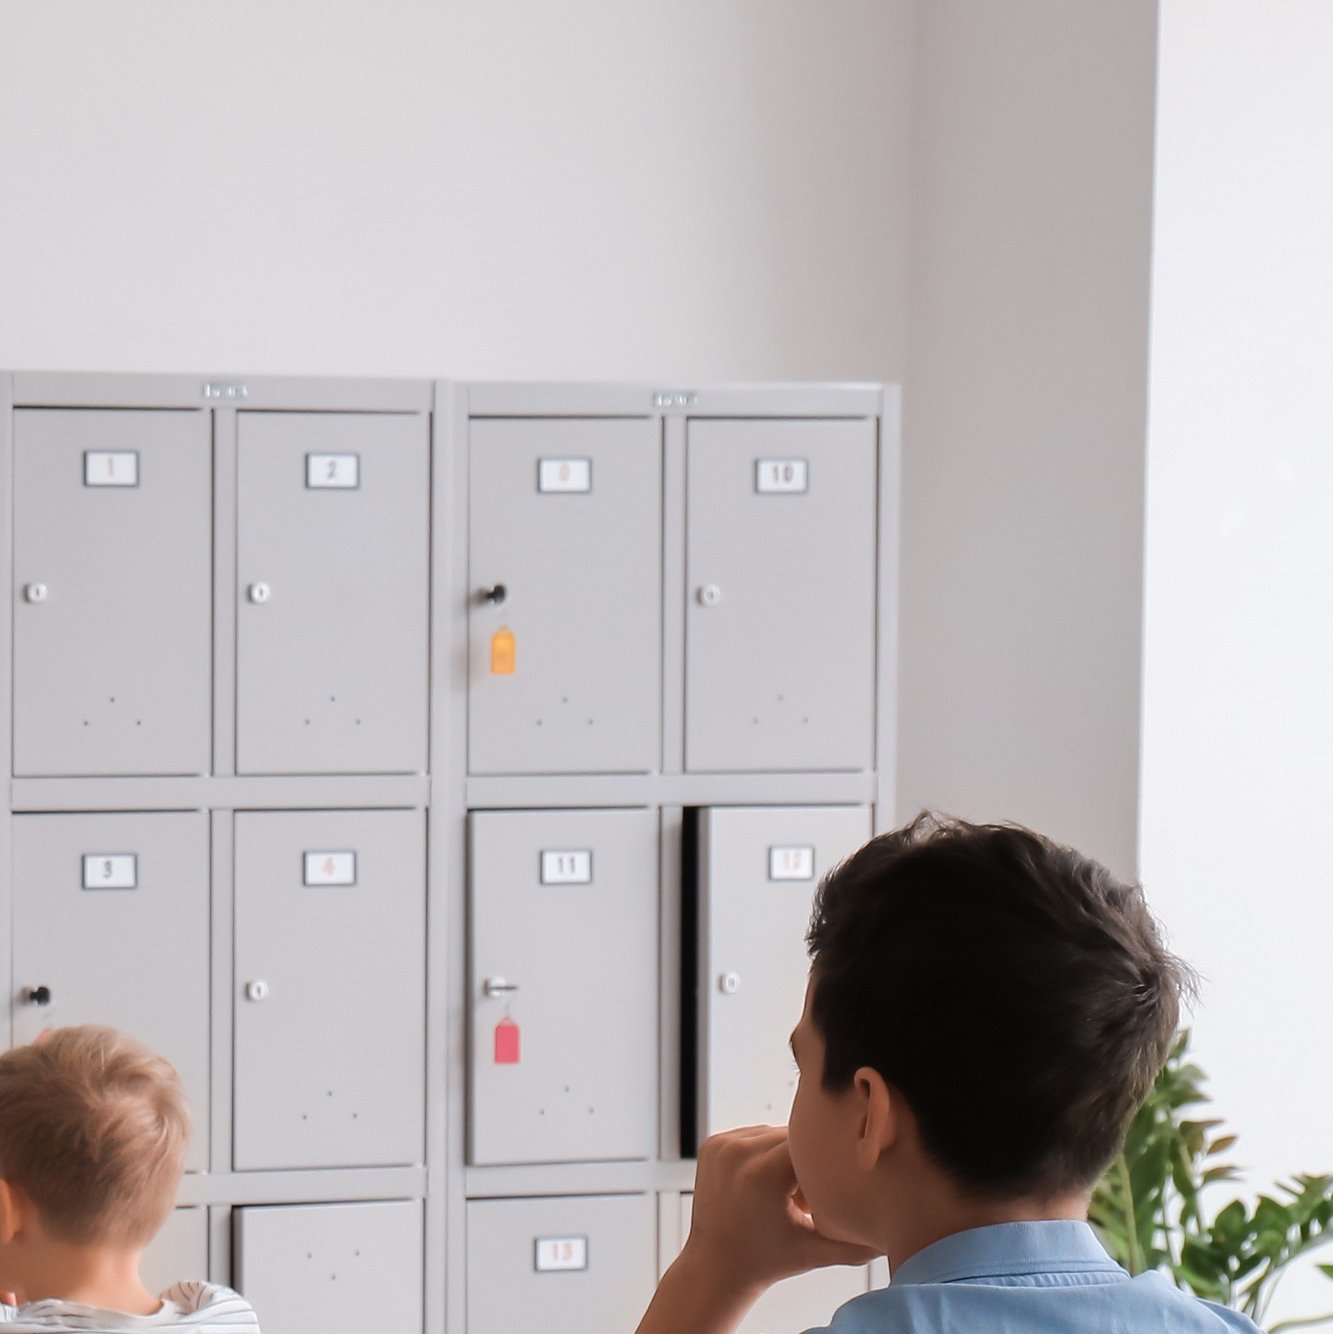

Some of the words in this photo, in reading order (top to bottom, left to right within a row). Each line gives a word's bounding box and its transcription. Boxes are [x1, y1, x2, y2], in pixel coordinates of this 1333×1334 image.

[328, 459, 338, 480] 2
[773, 463, 793, 483] 10
[103, 859, 113, 879] 3
[558, 856, 575, 874] 11
